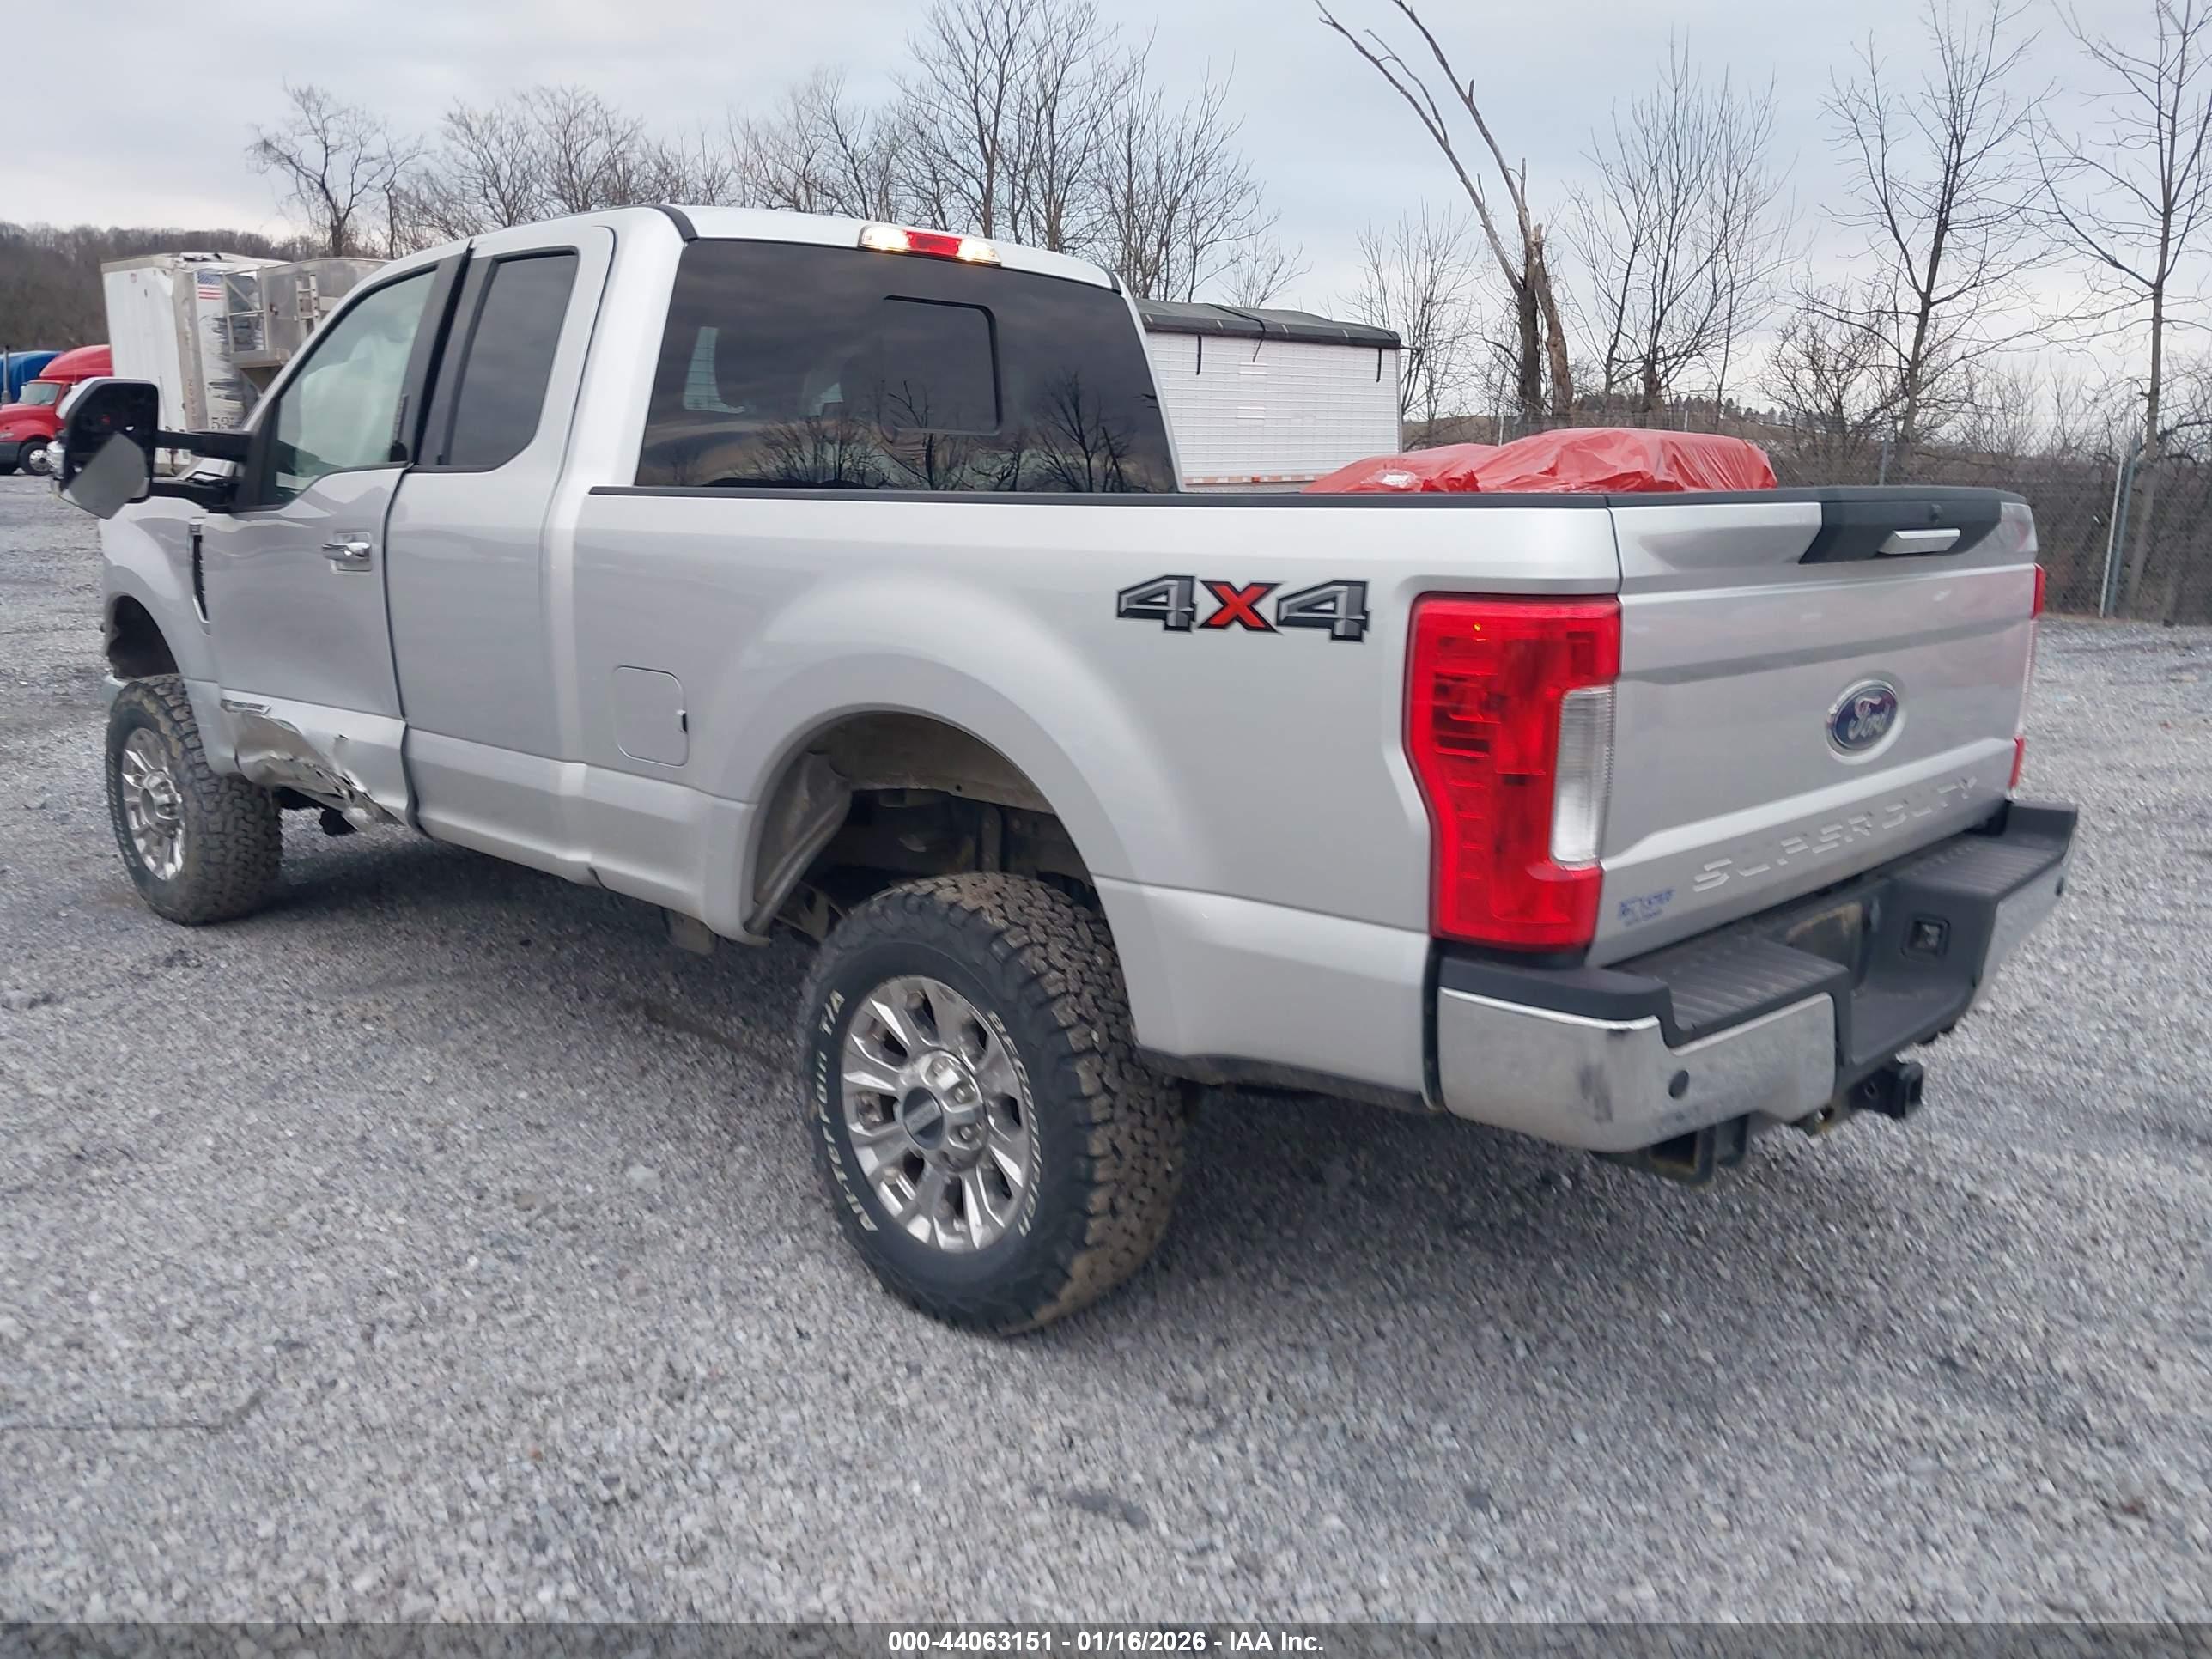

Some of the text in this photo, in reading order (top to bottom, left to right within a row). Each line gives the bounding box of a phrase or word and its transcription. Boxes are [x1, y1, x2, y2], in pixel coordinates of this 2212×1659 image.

[1847, 697, 1891, 740] Ford
[1693, 776, 1978, 893] SUPER DUTY
